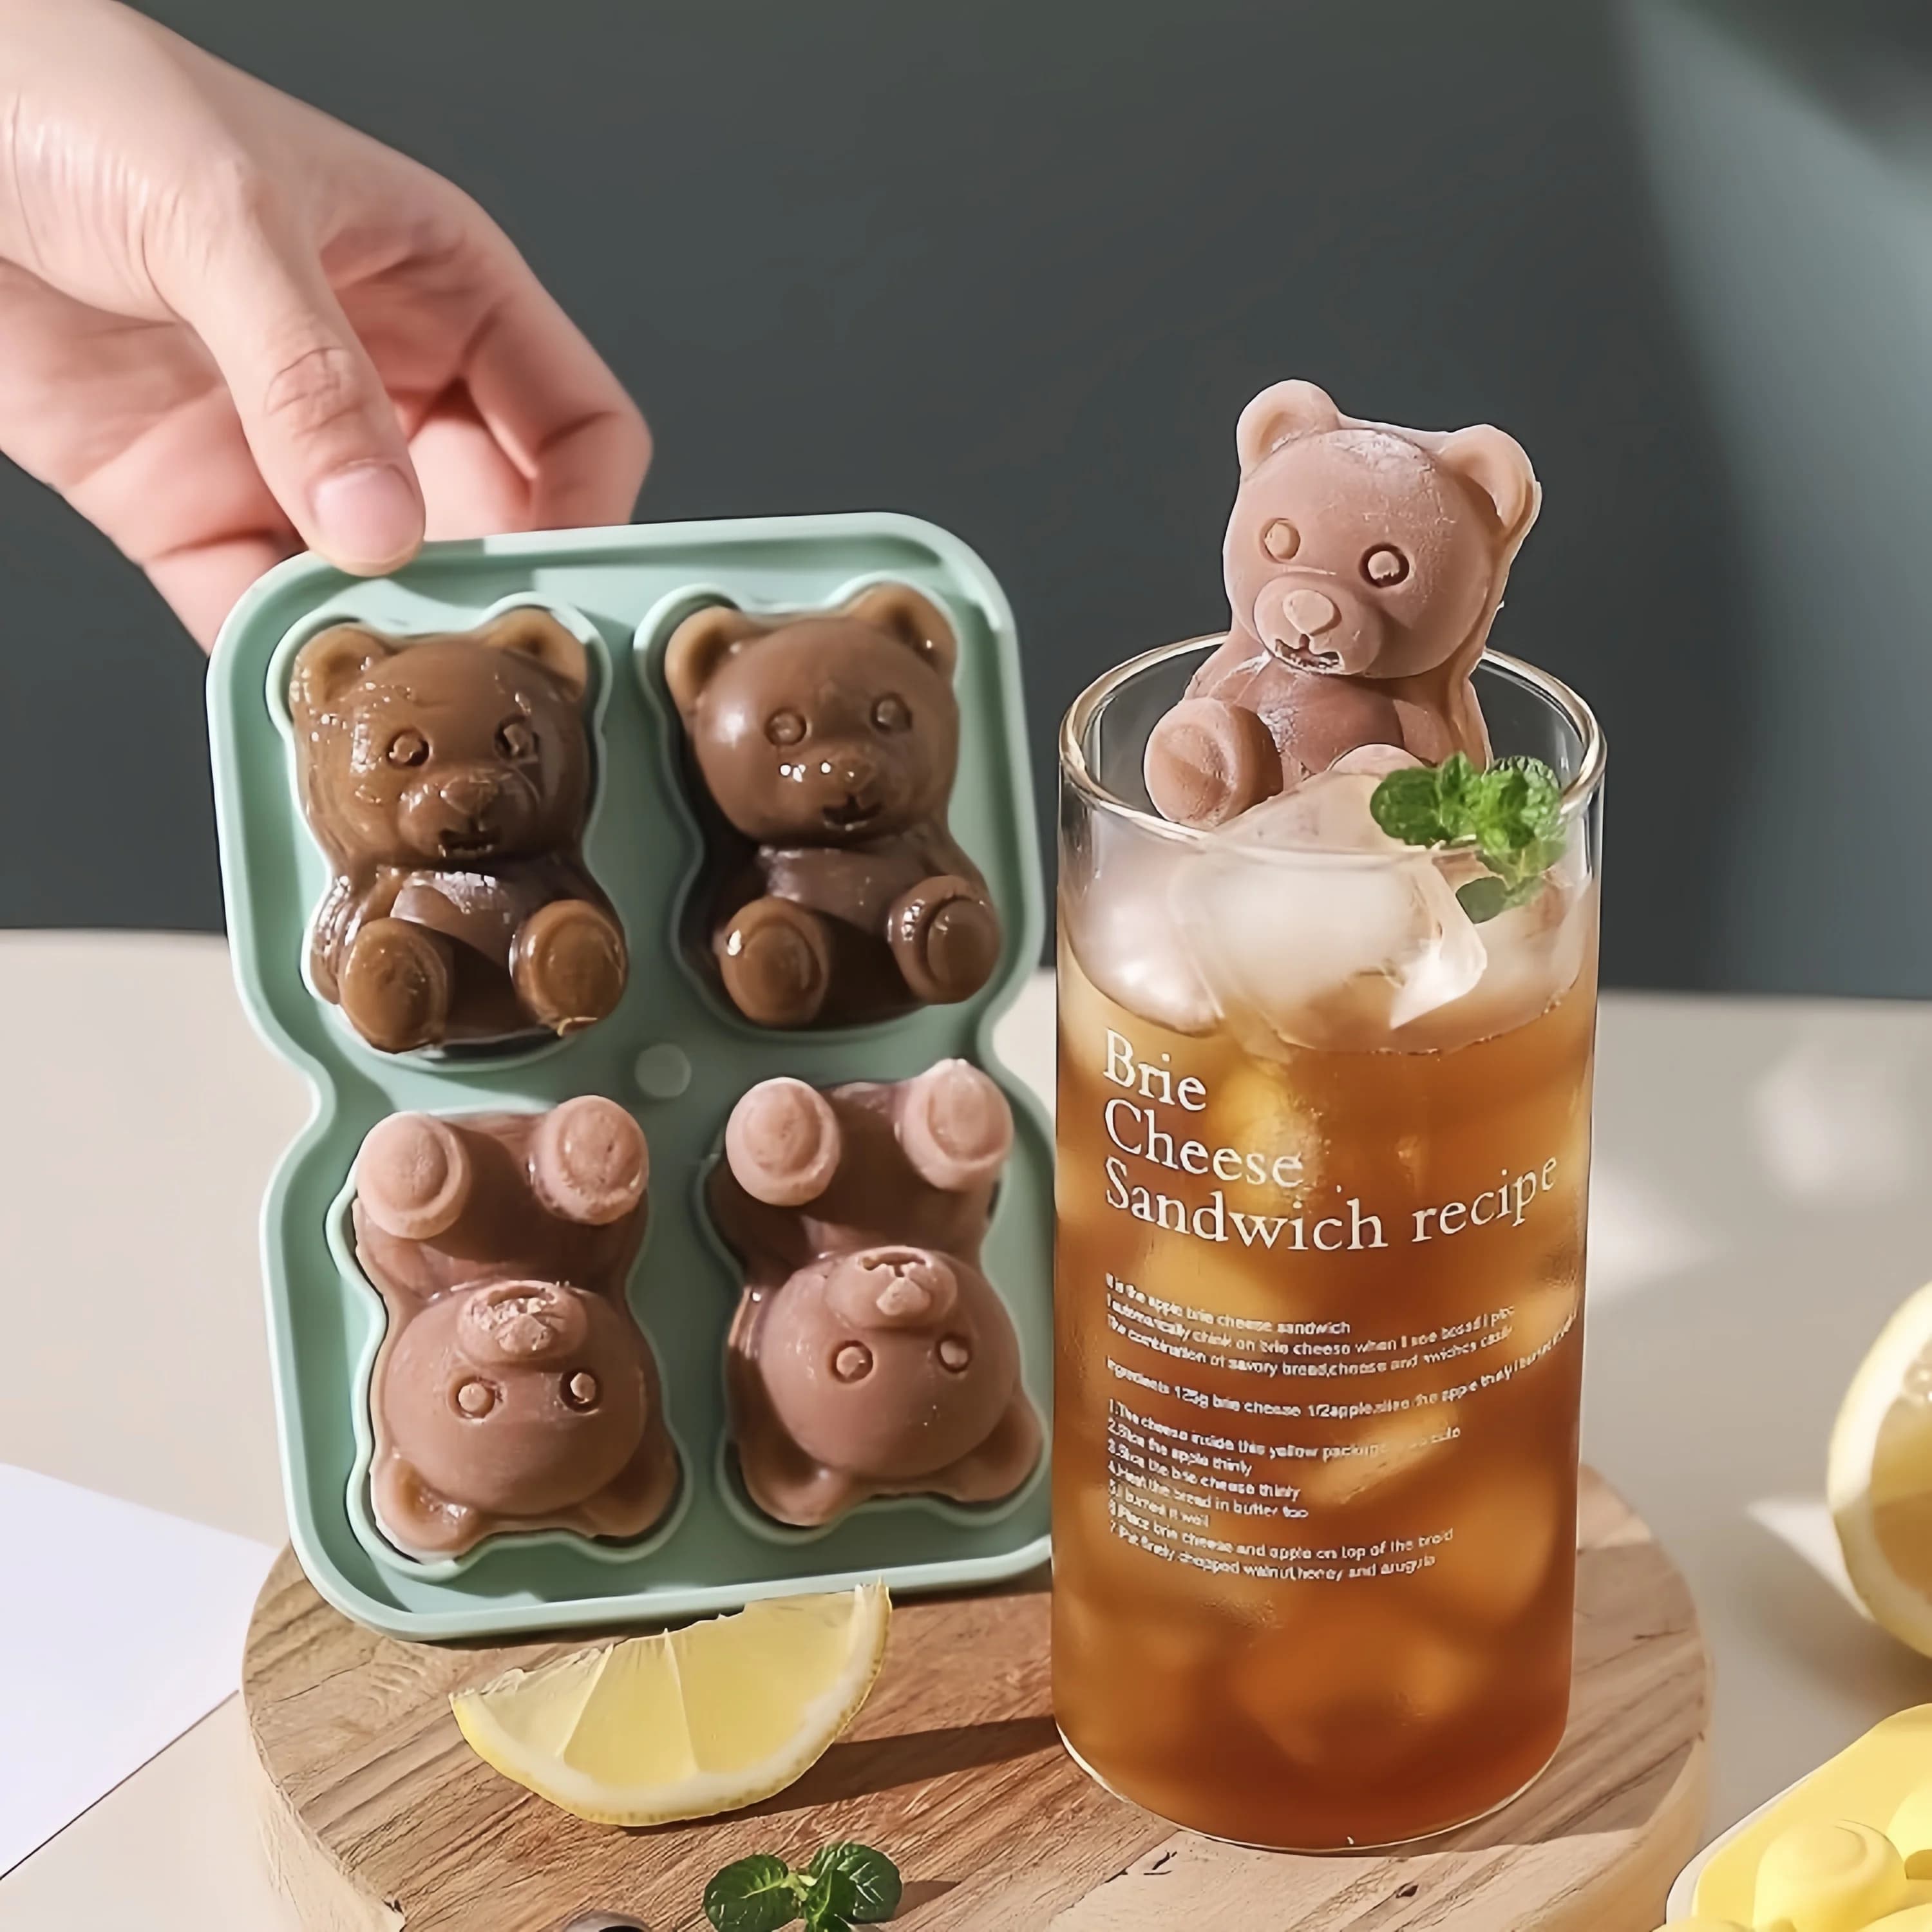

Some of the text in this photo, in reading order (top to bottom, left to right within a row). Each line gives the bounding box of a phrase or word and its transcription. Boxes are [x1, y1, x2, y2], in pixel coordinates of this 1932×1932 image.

[1103, 1028, 1206, 1112] Brie
[1104, 1099, 1305, 1188] Cheese
[1105, 1157, 1558, 1251] Sandwich recipe
[1277, 1321, 1350, 1335] sandwich
[1293, 1341, 1350, 1356] cheese
[1356, 1338, 1396, 1353] when
[1229, 1358, 1278, 1378] savory
[1390, 1354, 1419, 1370] and
[1244, 1401, 1302, 1417] cheese
[1269, 1444, 1319, 1460] yellow
[1215, 1501, 1230, 1512] in
[1233, 1499, 1278, 1517] butter
[1236, 1544, 1265, 1557] and
[1269, 1547, 1312, 1561] apple
[1341, 1546, 1366, 1561] top
[1370, 1540, 1387, 1557] of
[1390, 1538, 1414, 1553] the
[1349, 1563, 1377, 1578] and
